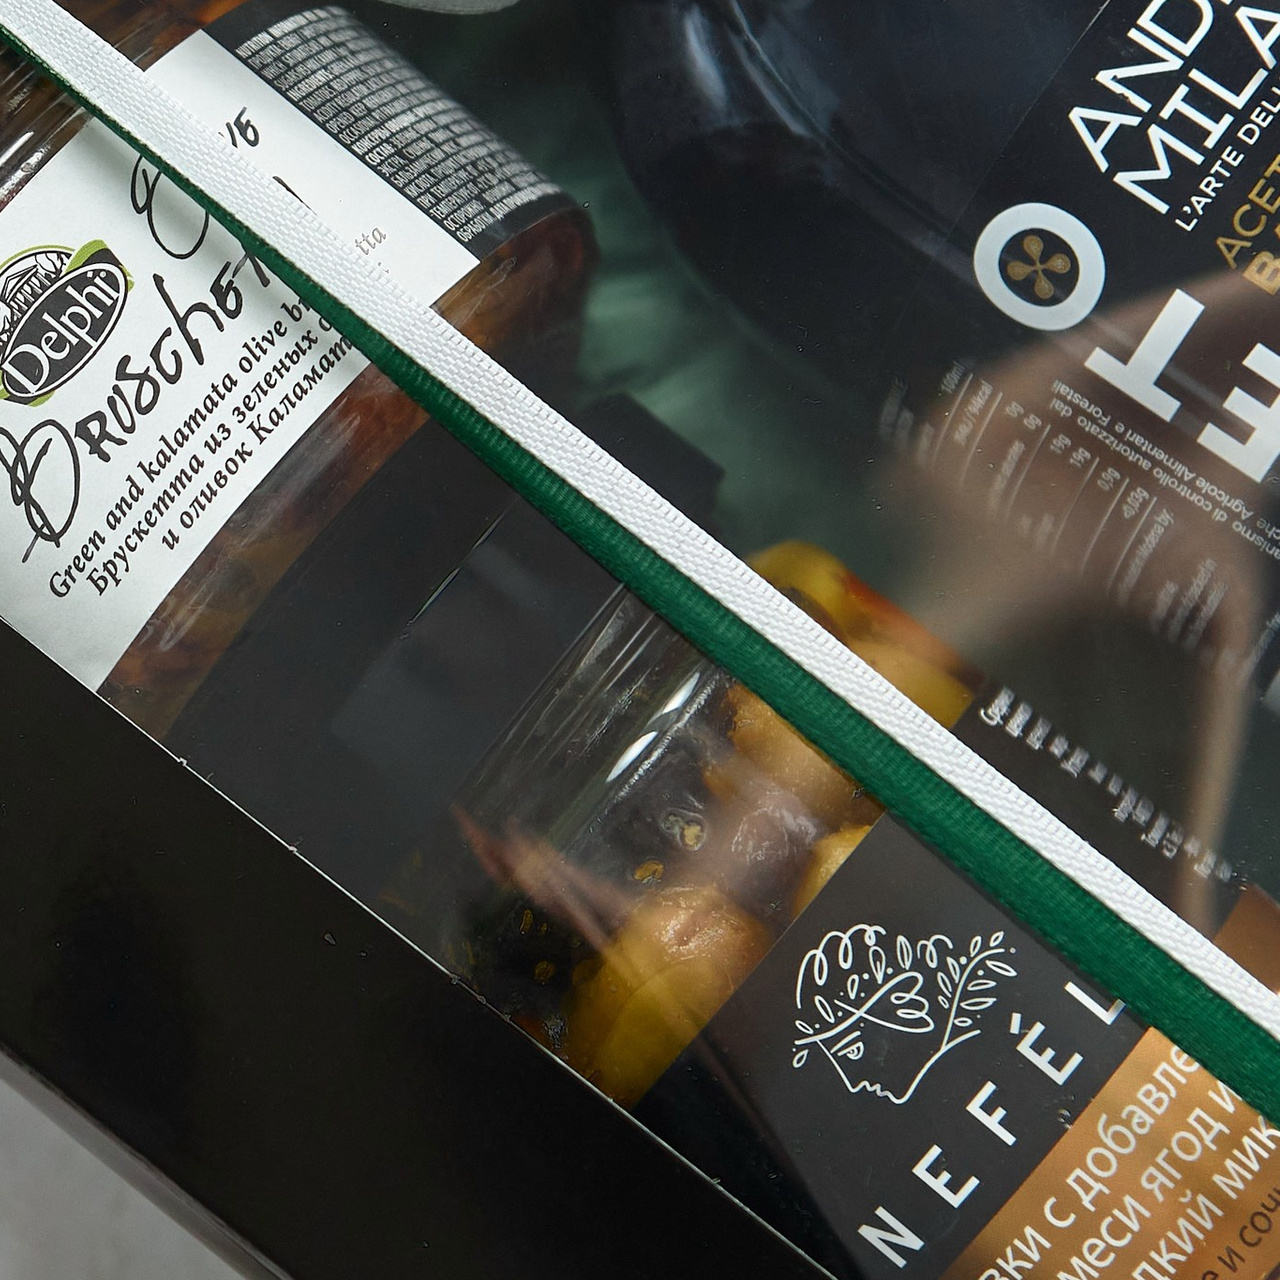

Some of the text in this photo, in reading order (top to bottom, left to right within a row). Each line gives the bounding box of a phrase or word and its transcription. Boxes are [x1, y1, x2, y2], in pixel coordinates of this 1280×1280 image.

[285, 67, 335, 101] INGREDIENTS:
[312, 101, 342, 123] ACIDITY
[325, 111, 355, 133] OPENED
[348, 103, 370, 117] KEEP
[350, 125, 392, 155] КОНСЕРВЫ
[363, 141, 397, 166] СОСТАВ:
[416, 192, 437, 208] ПРИ
[1, 268, 121, 393] Delphi
[1048, 396, 1074, 420] dal
[1049, 378, 1112, 426] Forestali
[161, 330, 356, 550] и оливок Каламат
[1073, 414, 1152, 472] autorizzato
[1112, 420, 1125, 433] e
[49, 530, 106, 598] Green
[106, 474, 145, 531] and
[136, 373, 238, 483] kalamata
[238, 320, 288, 374] olive
[85, 329, 319, 597] Брускетта из зеленых
[1123, 428, 1196, 483] Alimentari
[1149, 465, 1213, 514] controllo
[1192, 473, 1254, 522] Agricole
[1210, 506, 1229, 524] di
[1140, 1107, 1231, 1203] ягод
[1042, 1196, 1076, 1228] с
[1216, 1245, 1246, 1273] и
